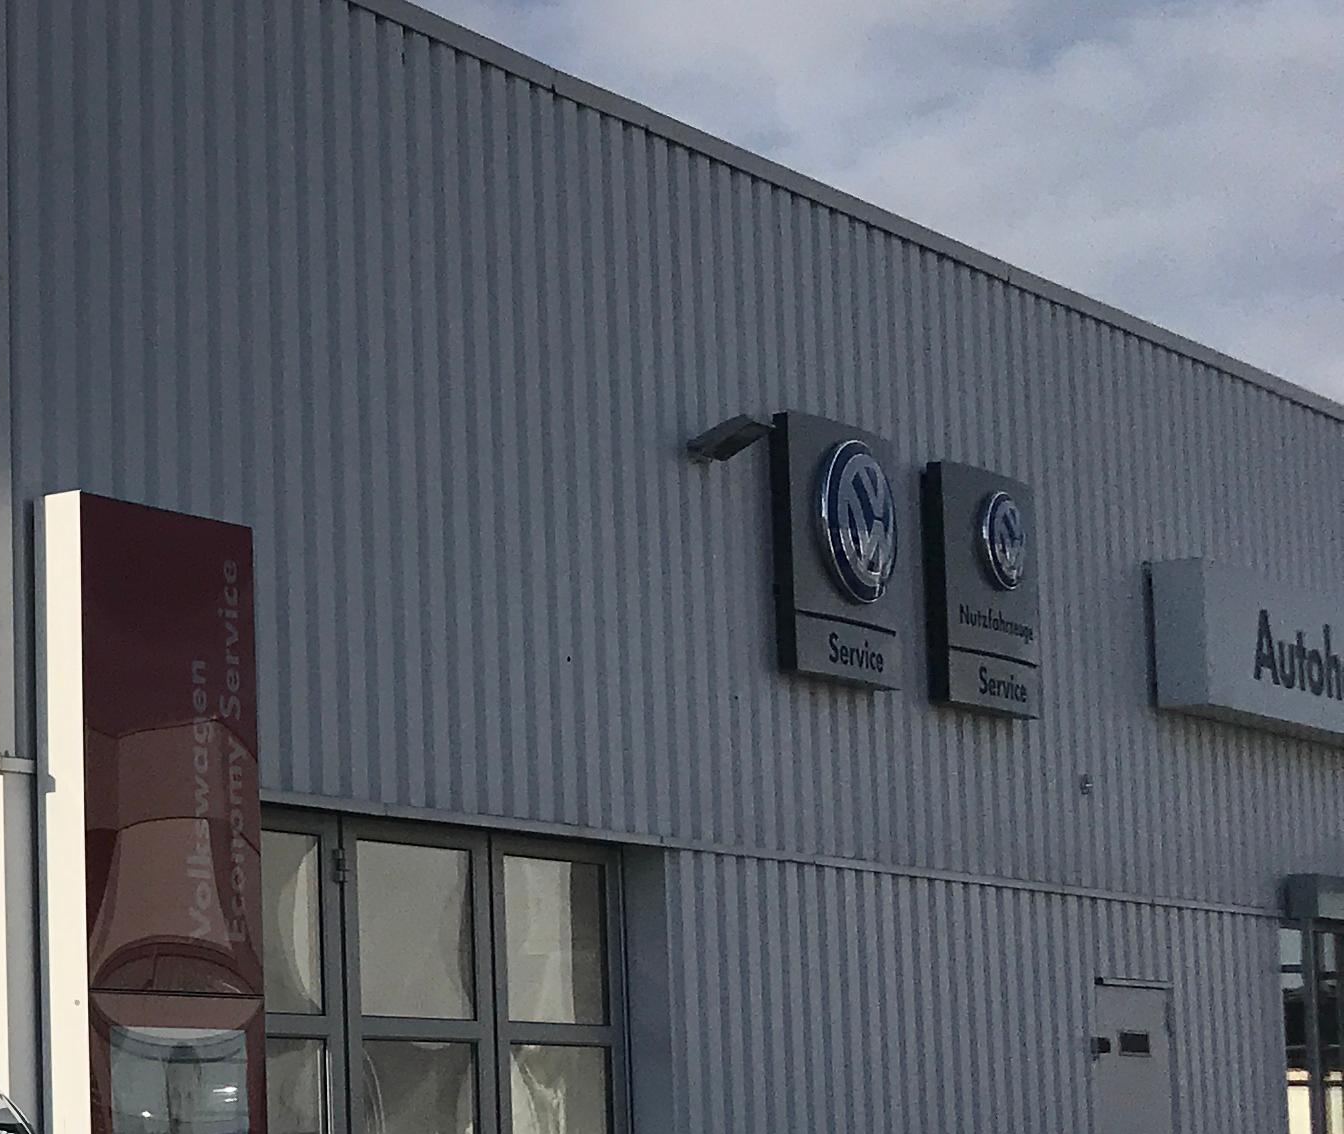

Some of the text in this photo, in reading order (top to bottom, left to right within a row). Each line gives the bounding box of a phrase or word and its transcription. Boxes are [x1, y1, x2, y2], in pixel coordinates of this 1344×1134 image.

[828, 631, 884, 673] Service
[959, 603, 1034, 645] Nutzfahrzeuge
[1253, 608, 1344, 701] Autoh
[978, 665, 1027, 703] Service
[218, 559, 246, 943] Economy Service
[186, 659, 214, 939] Volkswagen
